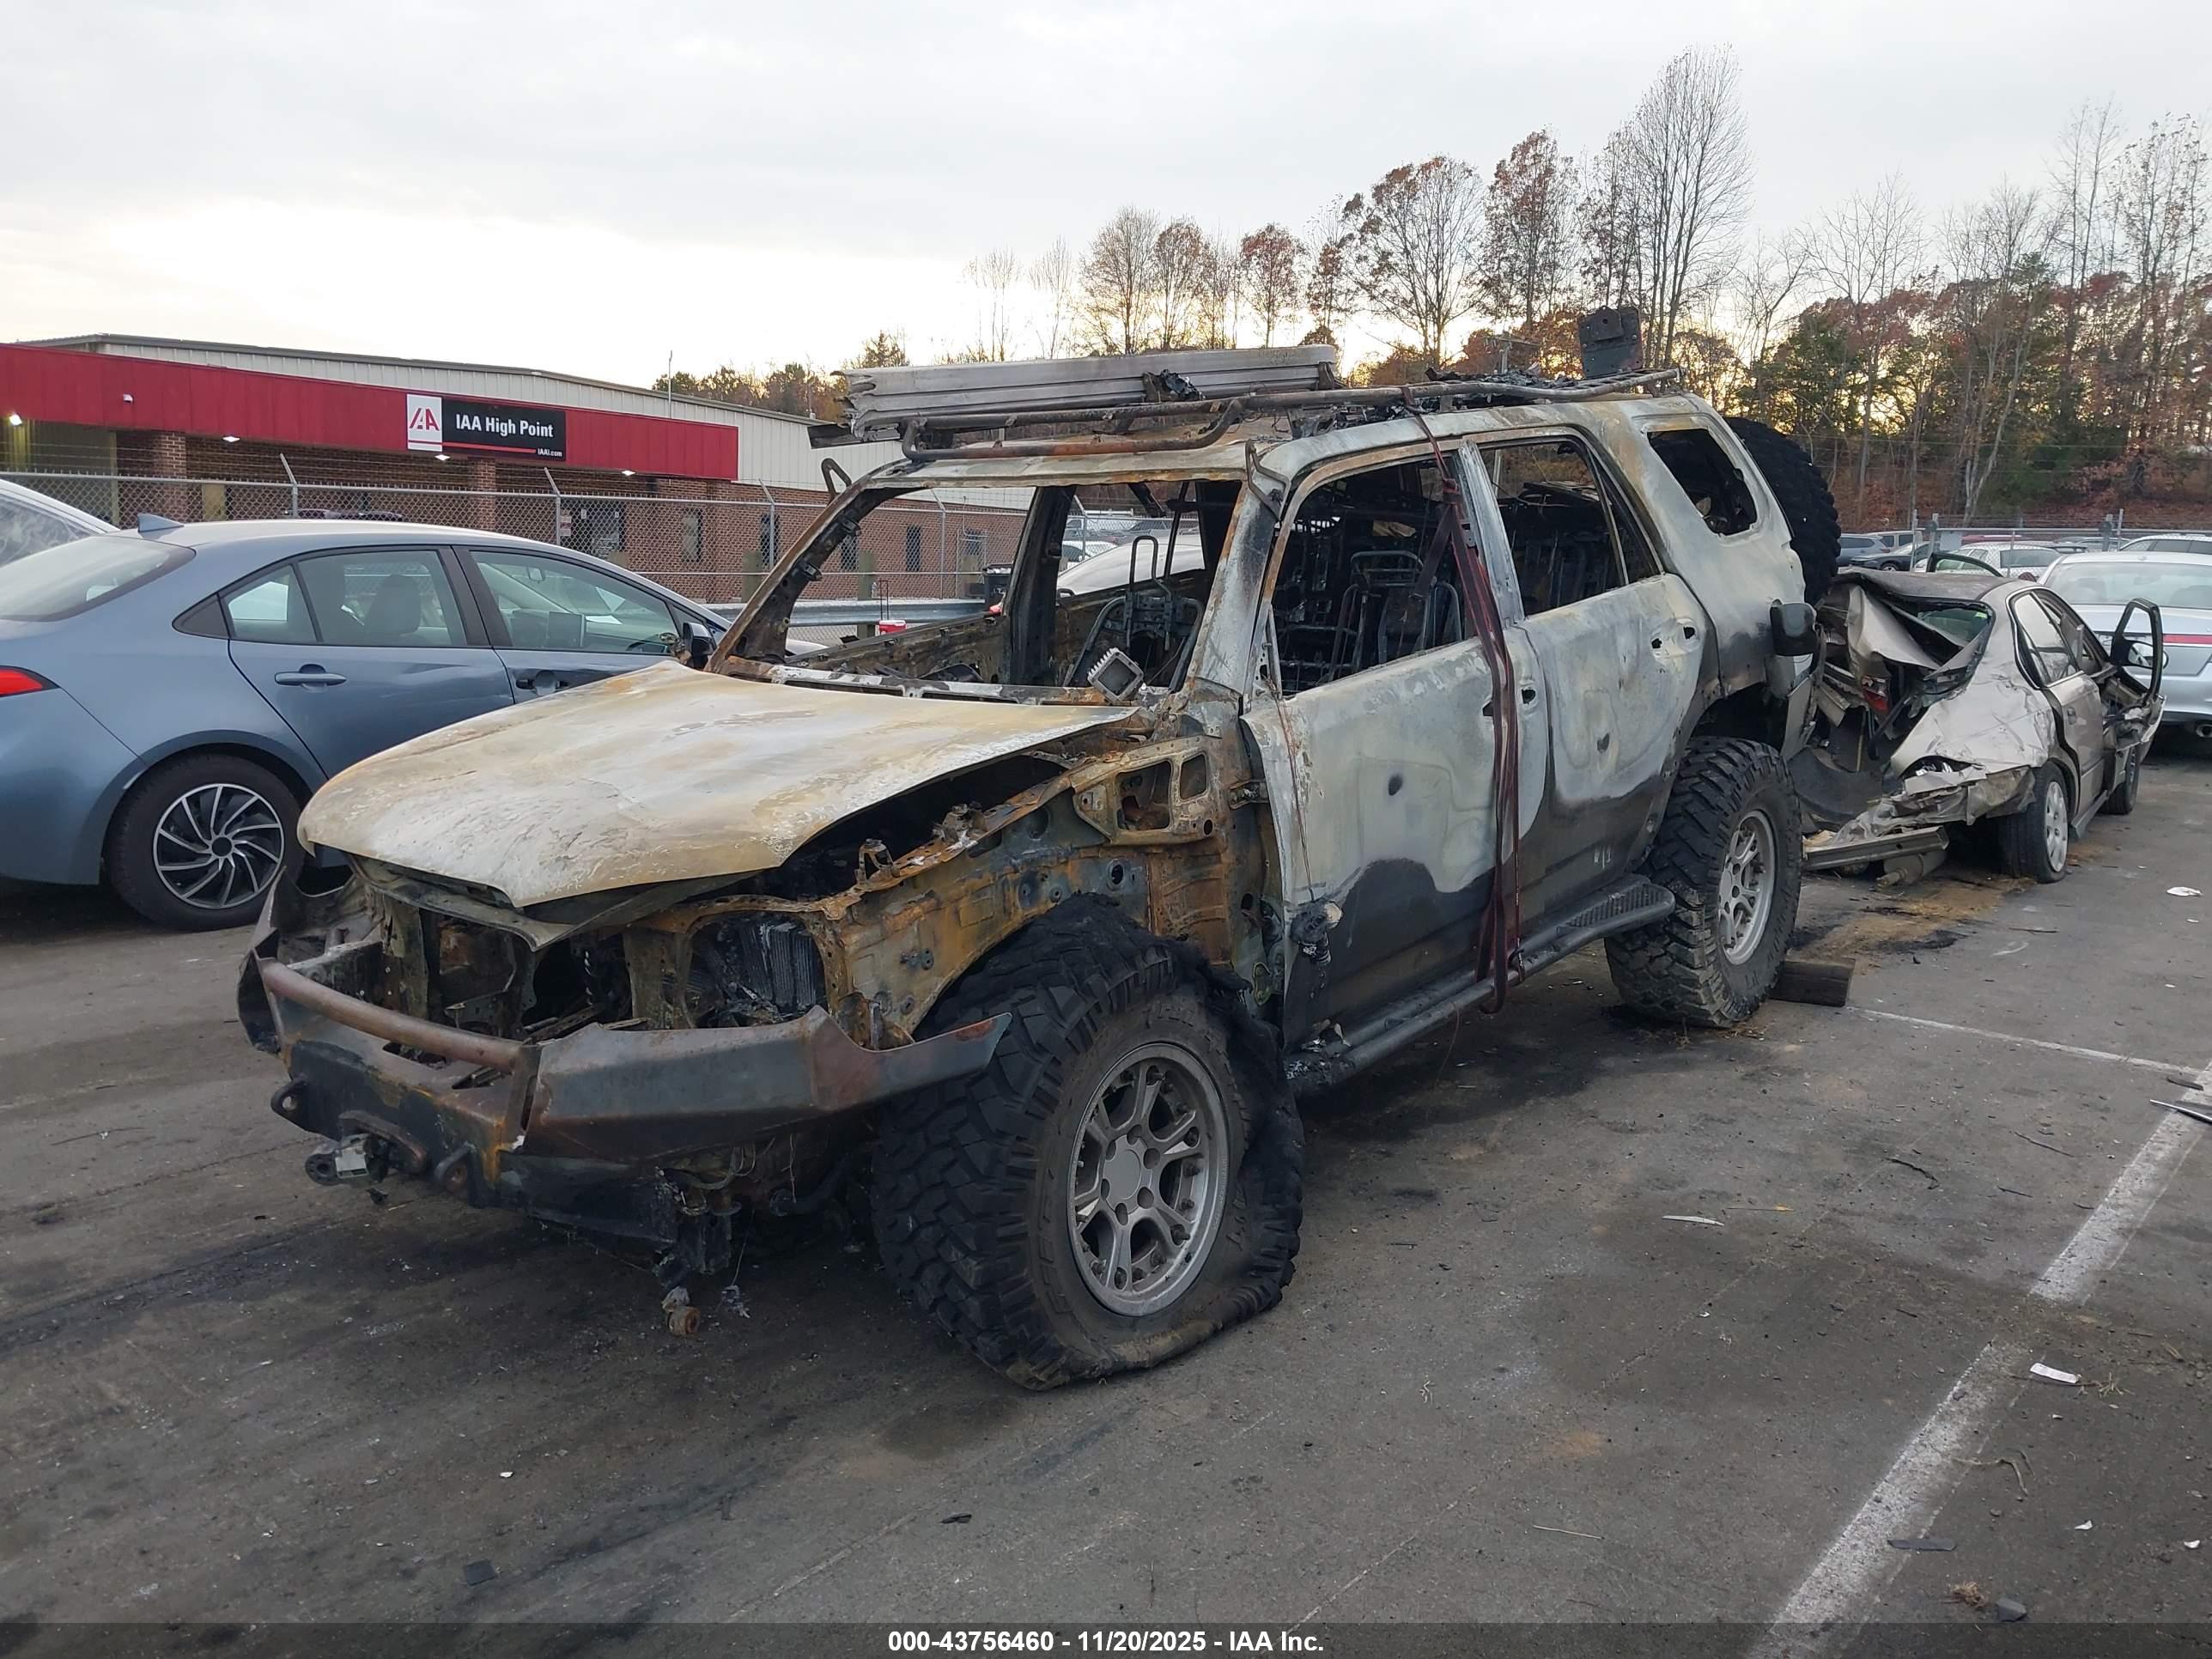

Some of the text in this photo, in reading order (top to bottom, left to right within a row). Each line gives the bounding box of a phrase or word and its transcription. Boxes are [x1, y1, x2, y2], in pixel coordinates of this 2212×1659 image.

[456, 414, 554, 438] IAA High Point
